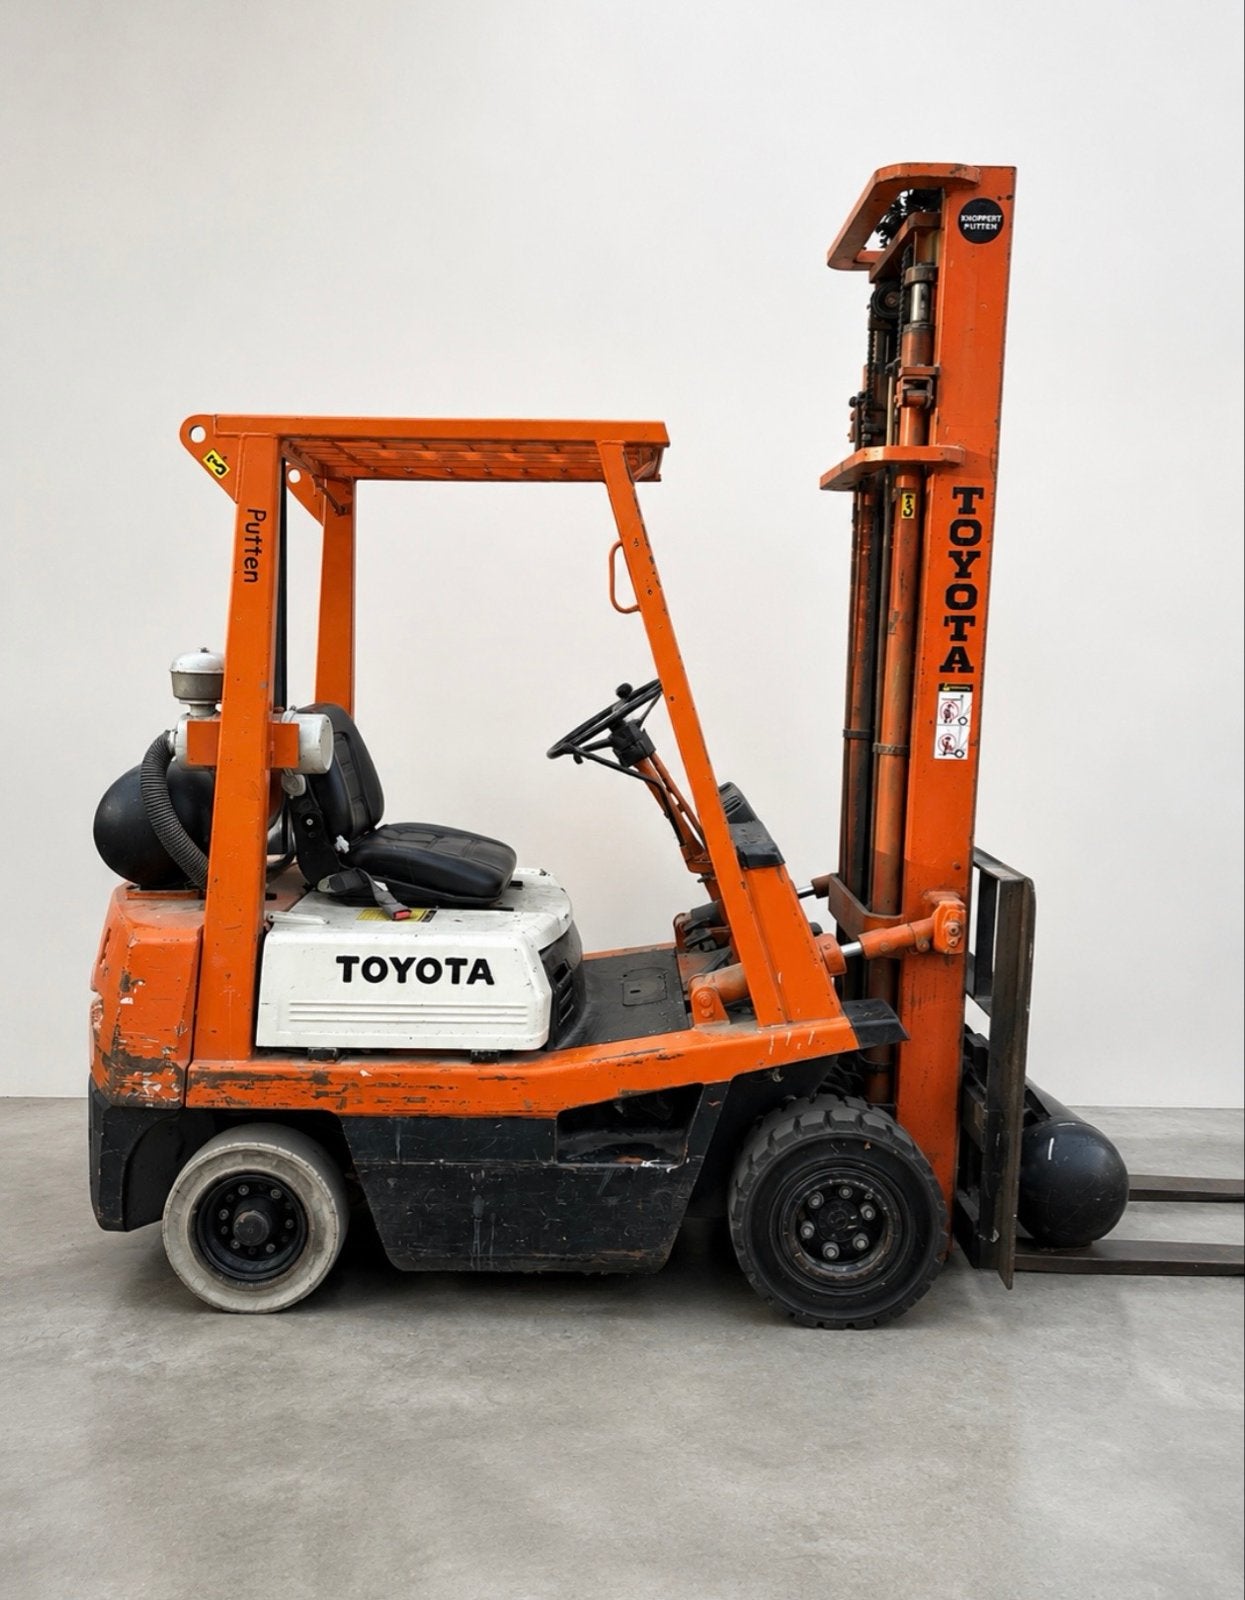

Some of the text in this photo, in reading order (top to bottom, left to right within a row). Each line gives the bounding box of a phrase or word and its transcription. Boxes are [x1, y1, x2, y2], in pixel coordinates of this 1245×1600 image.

[963, 223, 998, 231] PUTTEN
[243, 508, 267, 584] Putten
[939, 486, 985, 674] TOYOTA
[336, 955, 495, 986] TOYOTA
